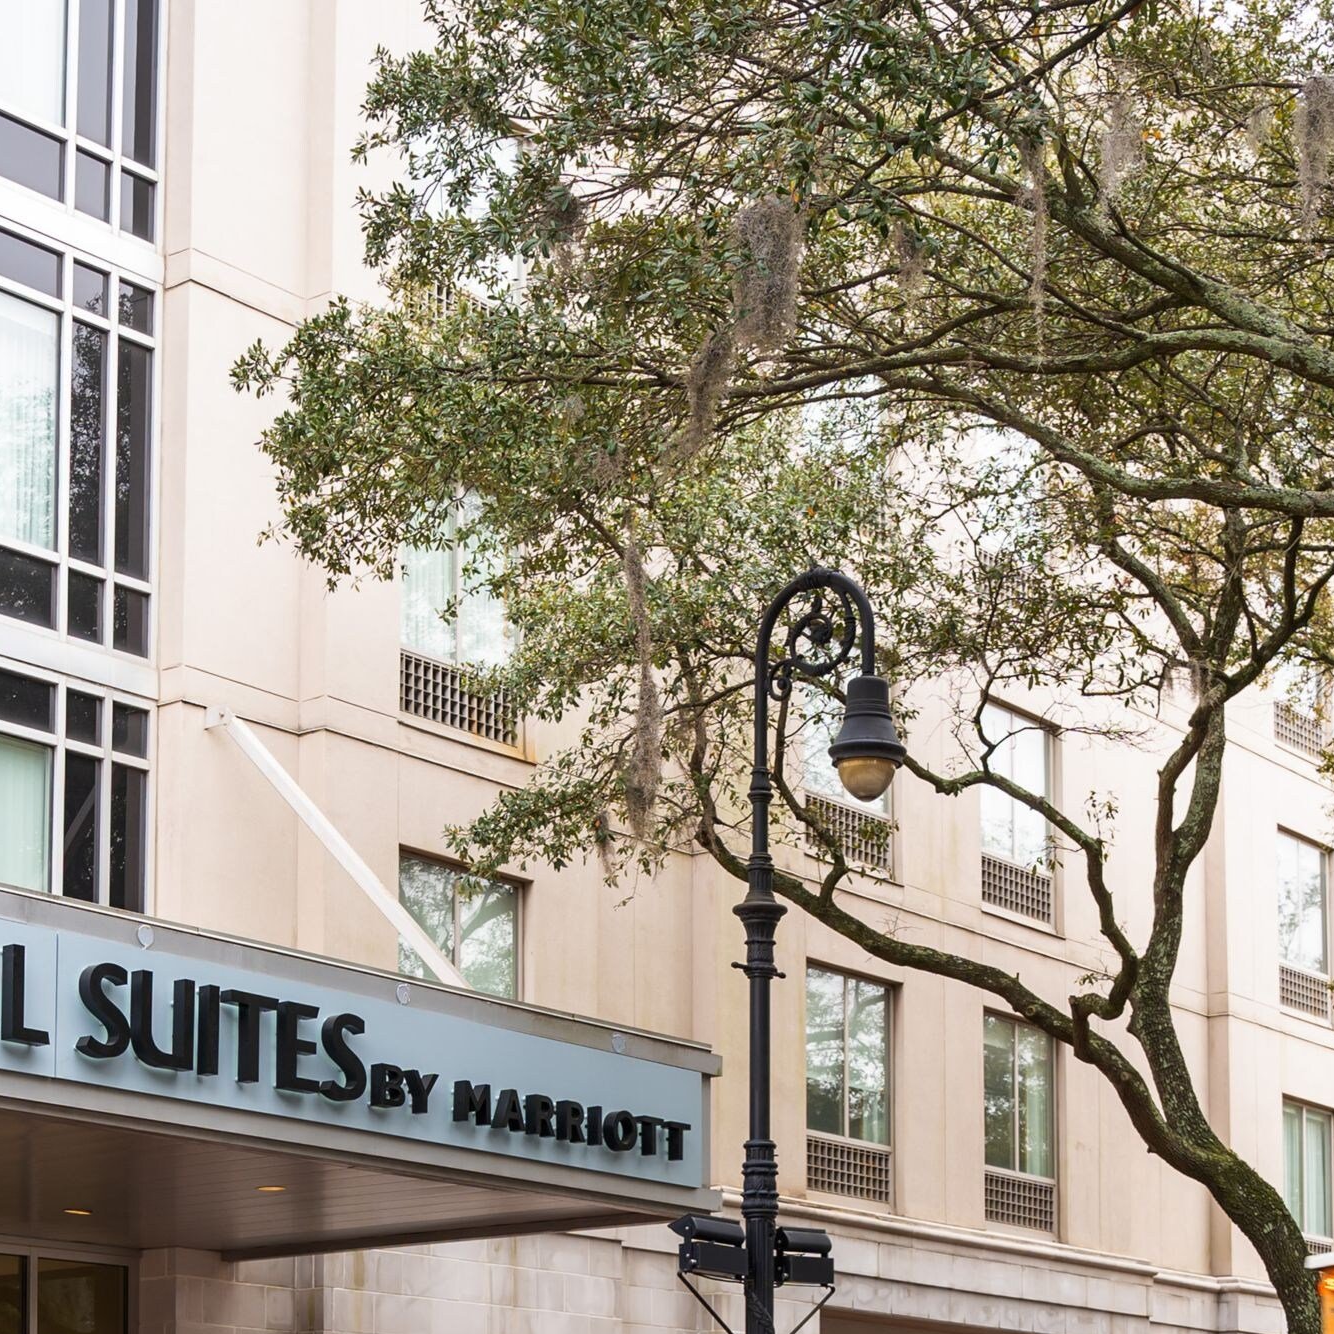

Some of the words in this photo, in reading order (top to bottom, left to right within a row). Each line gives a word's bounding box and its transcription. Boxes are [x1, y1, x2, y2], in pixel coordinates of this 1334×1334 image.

[74, 962, 367, 1101] SUITES
[370, 1063, 439, 1114] BY
[453, 1080, 692, 1161] MARRIOTT
